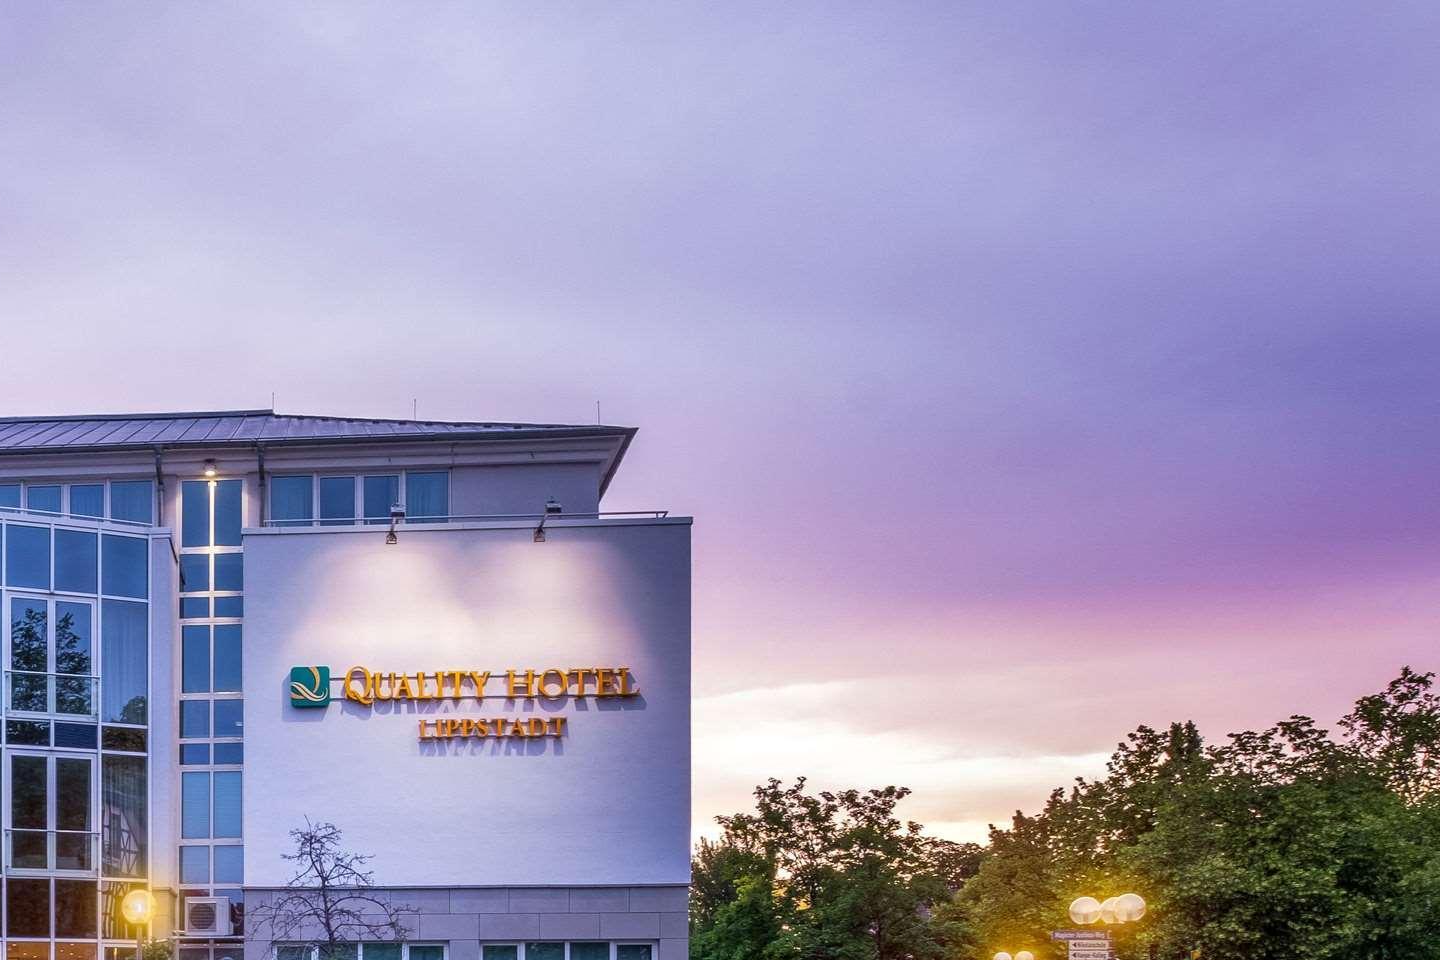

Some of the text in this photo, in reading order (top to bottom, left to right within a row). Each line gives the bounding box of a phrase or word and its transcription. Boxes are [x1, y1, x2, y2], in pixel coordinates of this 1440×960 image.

[344, 665, 641, 705] QUALITY HOTEL
[418, 717, 568, 739] LIPPSTADT
